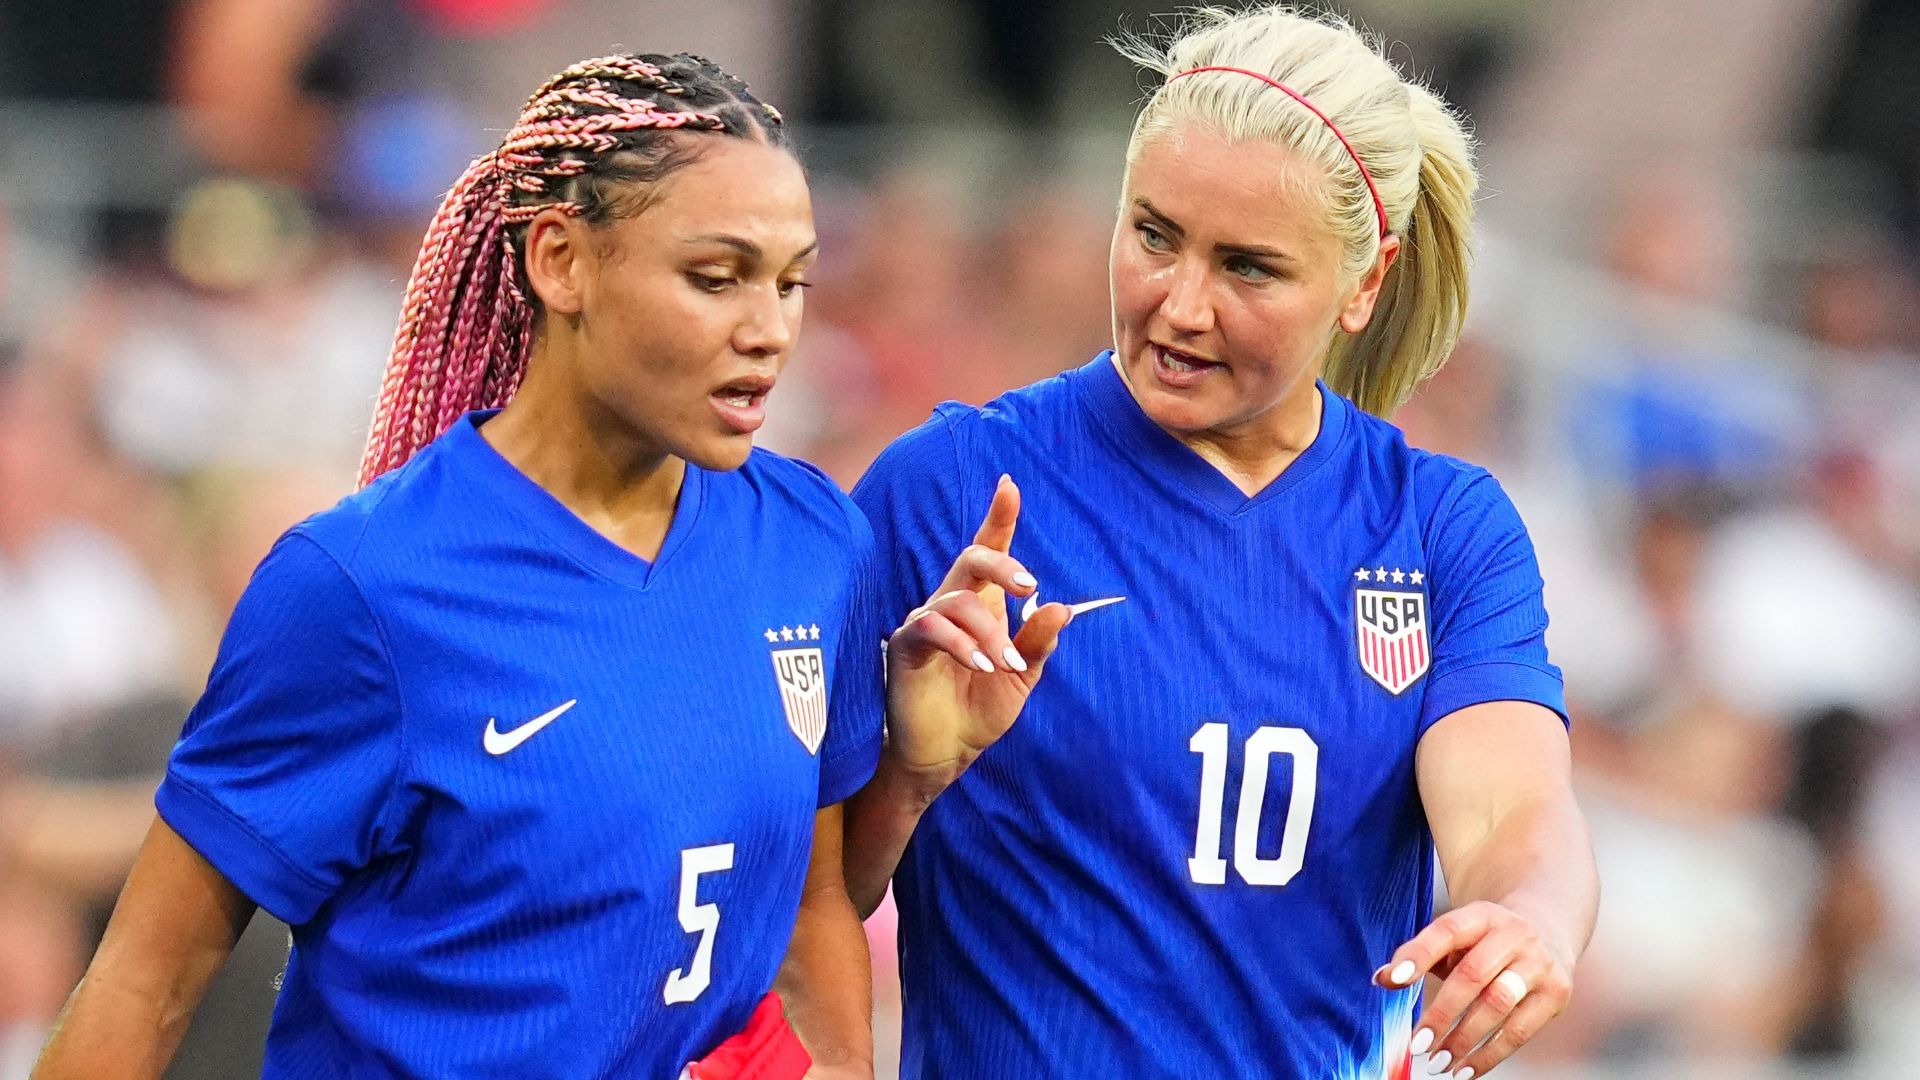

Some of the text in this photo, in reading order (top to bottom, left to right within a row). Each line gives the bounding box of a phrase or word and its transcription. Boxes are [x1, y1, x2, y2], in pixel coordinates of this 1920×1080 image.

[1361, 595, 1420, 635] USA
[778, 655, 820, 692] USA
[1188, 722, 1319, 886] 10
[663, 843, 735, 1006] 5
